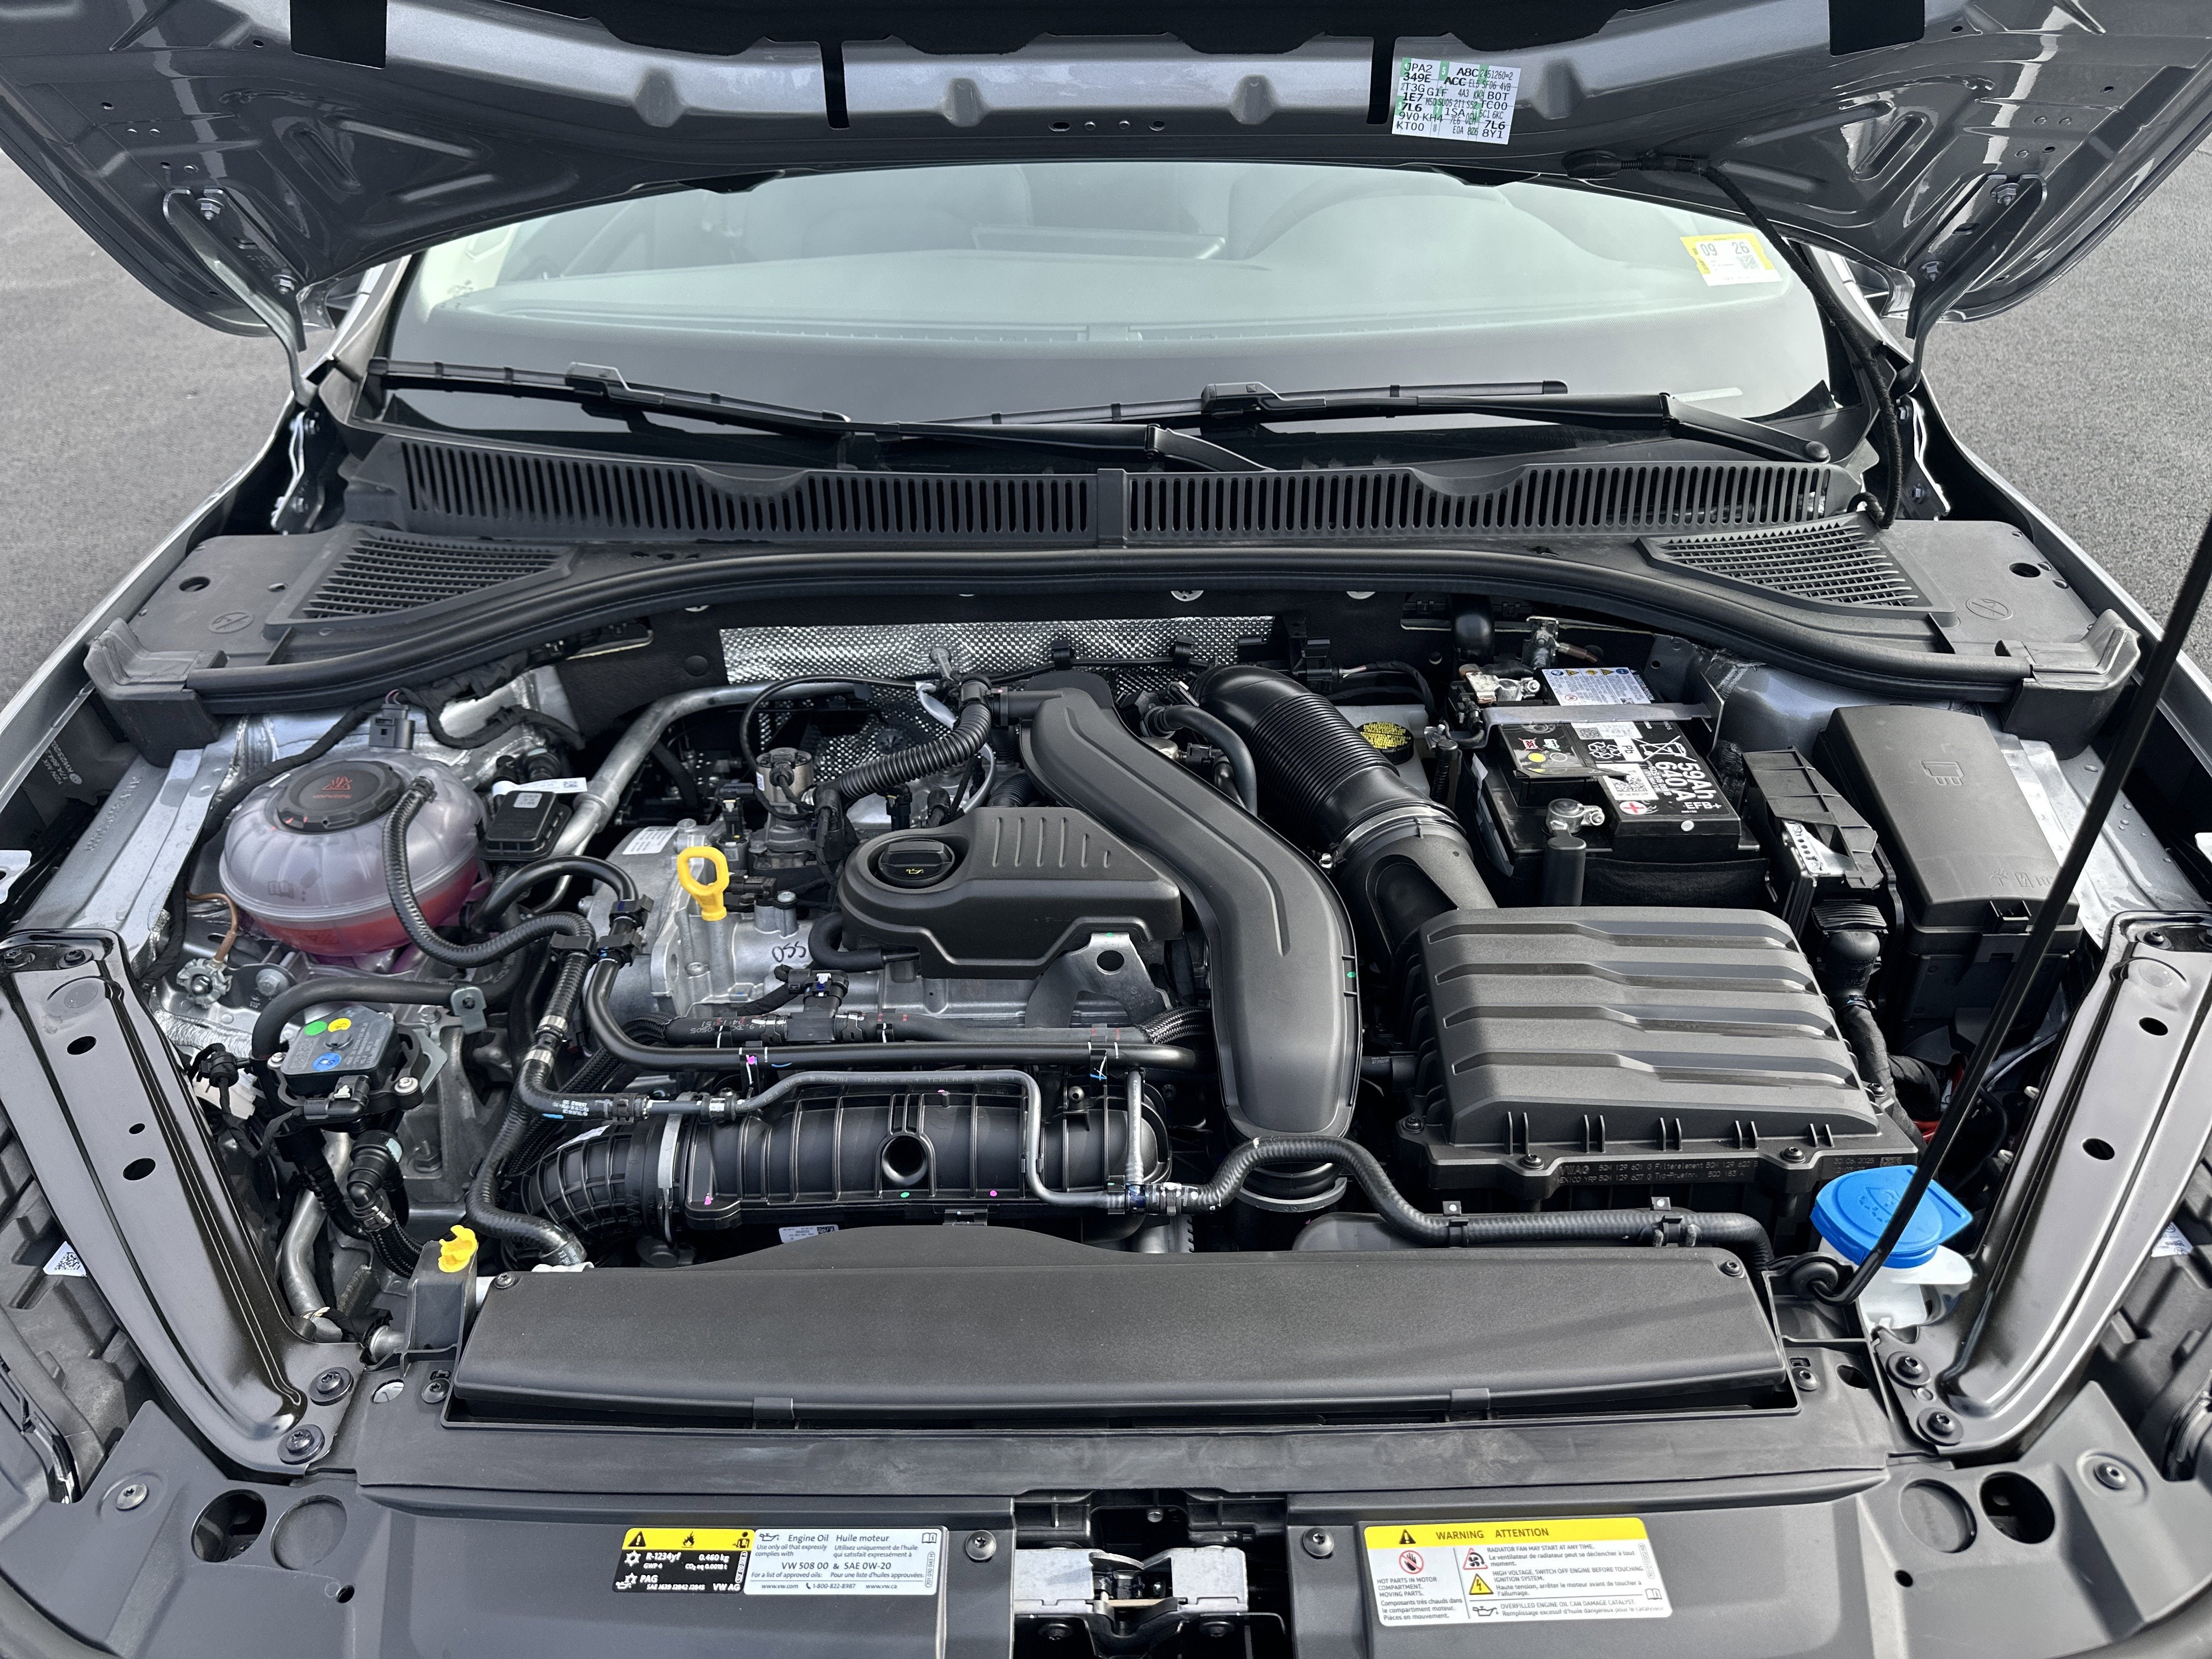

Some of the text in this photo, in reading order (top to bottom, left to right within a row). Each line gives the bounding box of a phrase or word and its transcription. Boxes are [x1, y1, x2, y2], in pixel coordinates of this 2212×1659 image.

[1404, 62, 1432, 73] JPA2
[1456, 67, 1479, 77] A8C
[1403, 72, 1431, 83] 349E
[1443, 76, 1466, 86] ACC
[1404, 82, 1425, 92] T3G
[1403, 92, 1423, 102] 1E7
[1458, 88, 1469, 97] 4A3
[1402, 102, 1423, 112] 7L6
[1484, 120, 1505, 129] 7L6
[1482, 129, 1503, 138] 8Y1
[1700, 241, 1750, 256] 09 26
[1655, 761, 1696, 802] 640 A
[1677, 762, 1717, 799] 59Ah
[1684, 801, 1722, 810] EFB+
[1435, 1527, 1549, 1539] WARNING ATTENTION
[788, 1534, 815, 1543] Engine
[639, 1575, 658, 1583] PAG
[713, 1583, 741, 1591] VW AG
